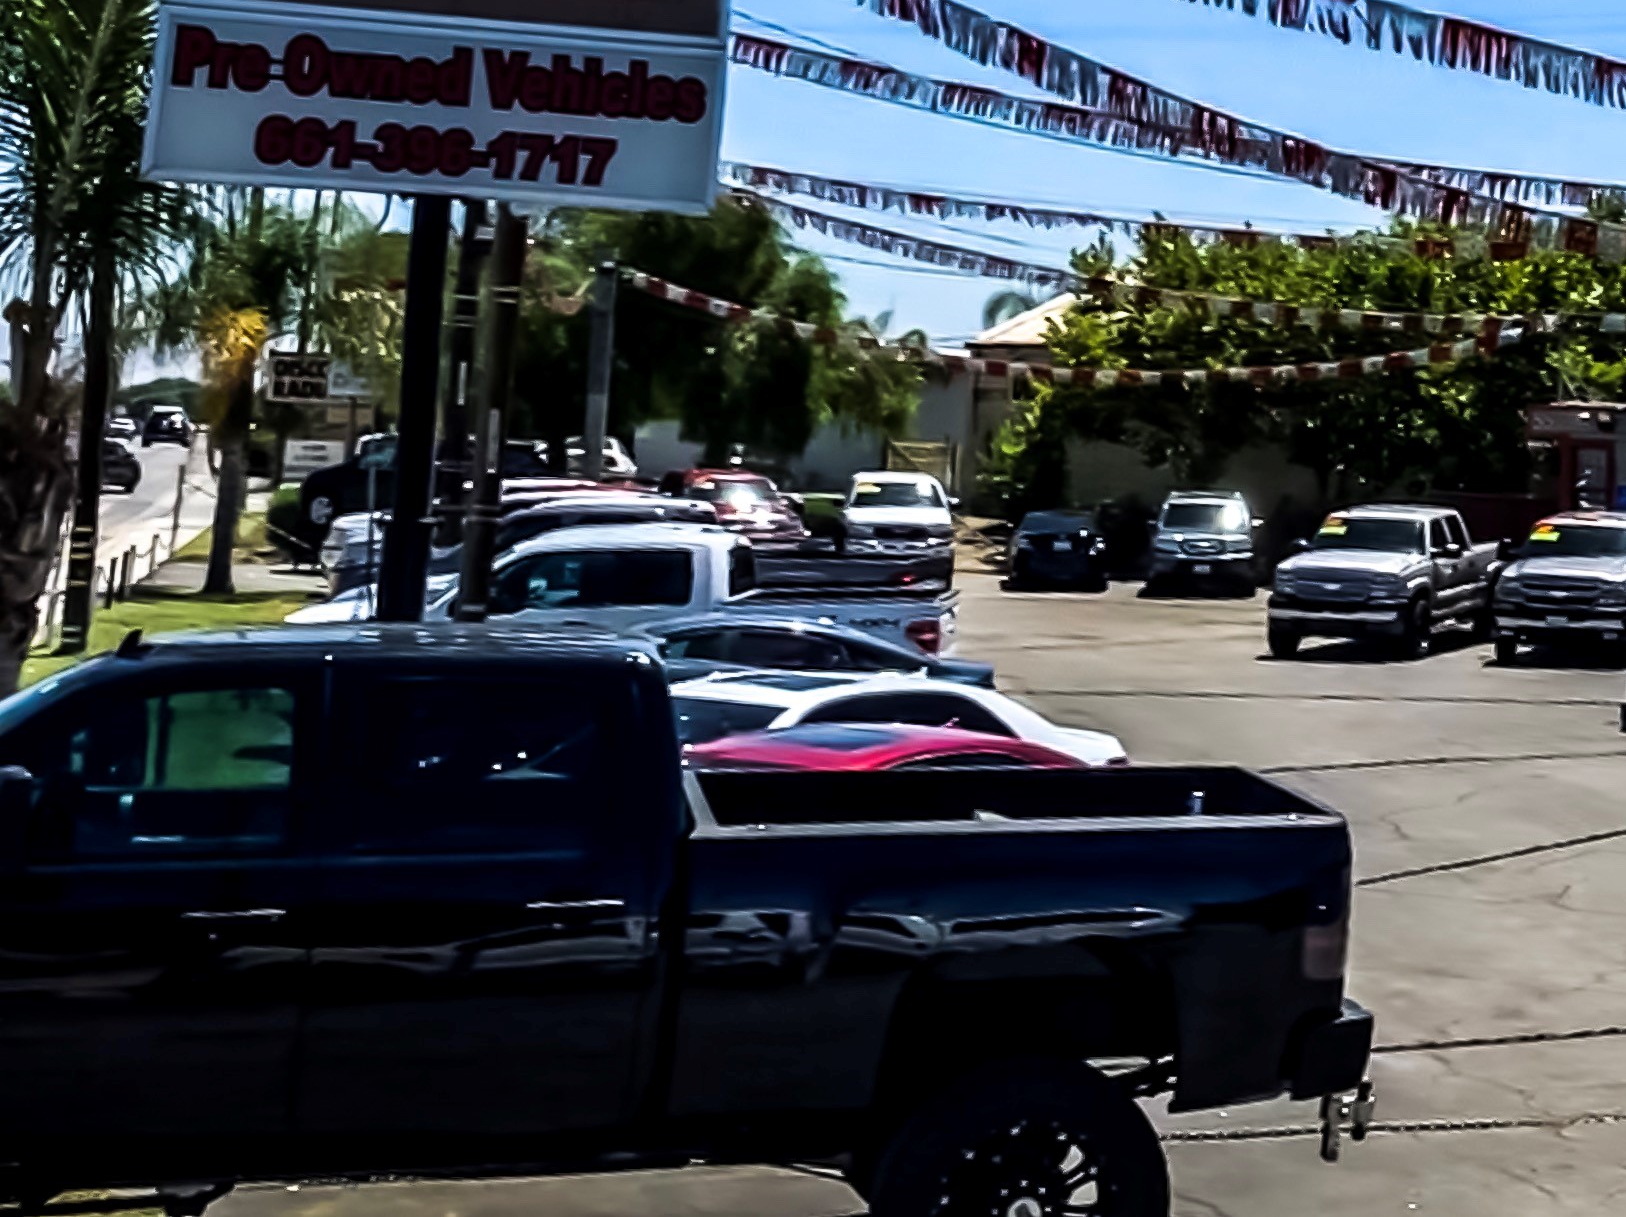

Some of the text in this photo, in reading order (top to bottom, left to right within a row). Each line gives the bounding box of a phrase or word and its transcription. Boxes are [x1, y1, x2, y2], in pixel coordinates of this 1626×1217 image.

[171, 24, 708, 124] Pre-Owned Vehicles
[255, 115, 619, 186] 661-396-1717
